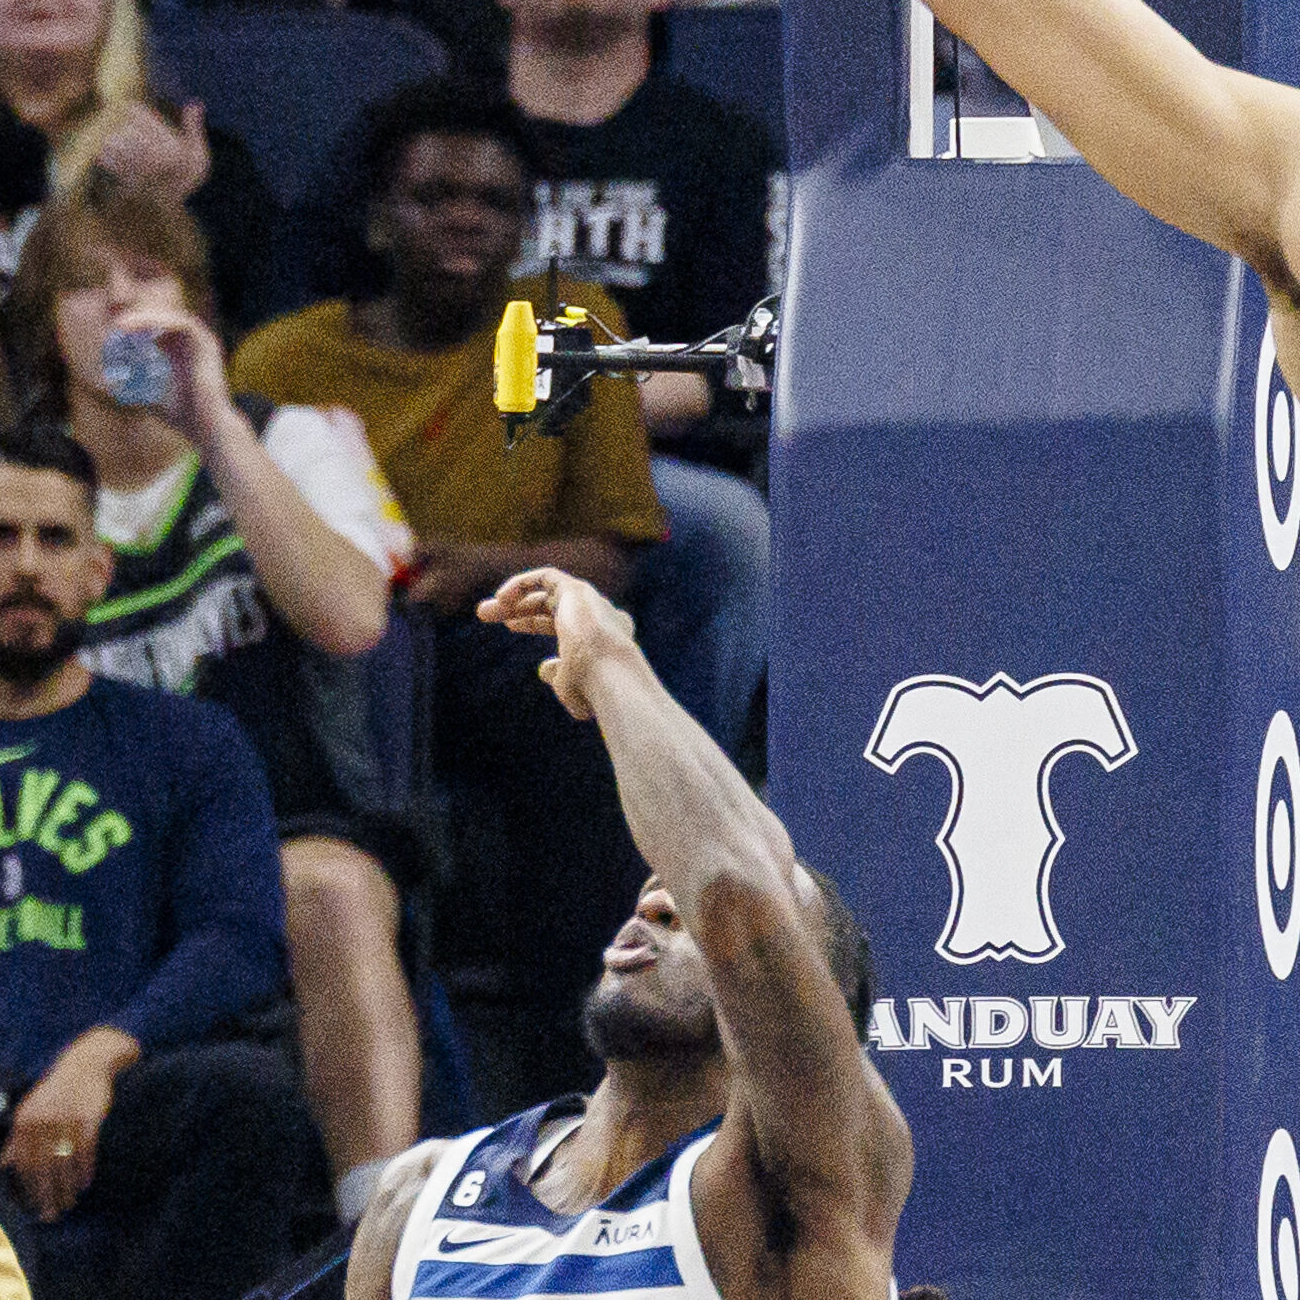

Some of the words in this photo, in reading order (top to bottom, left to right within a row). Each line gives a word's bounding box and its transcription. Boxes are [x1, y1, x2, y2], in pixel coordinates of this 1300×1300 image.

[867, 995, 1198, 1052] ANDUAY
[941, 1057, 1063, 1089] RUM
[452, 1169, 487, 1208] 6
